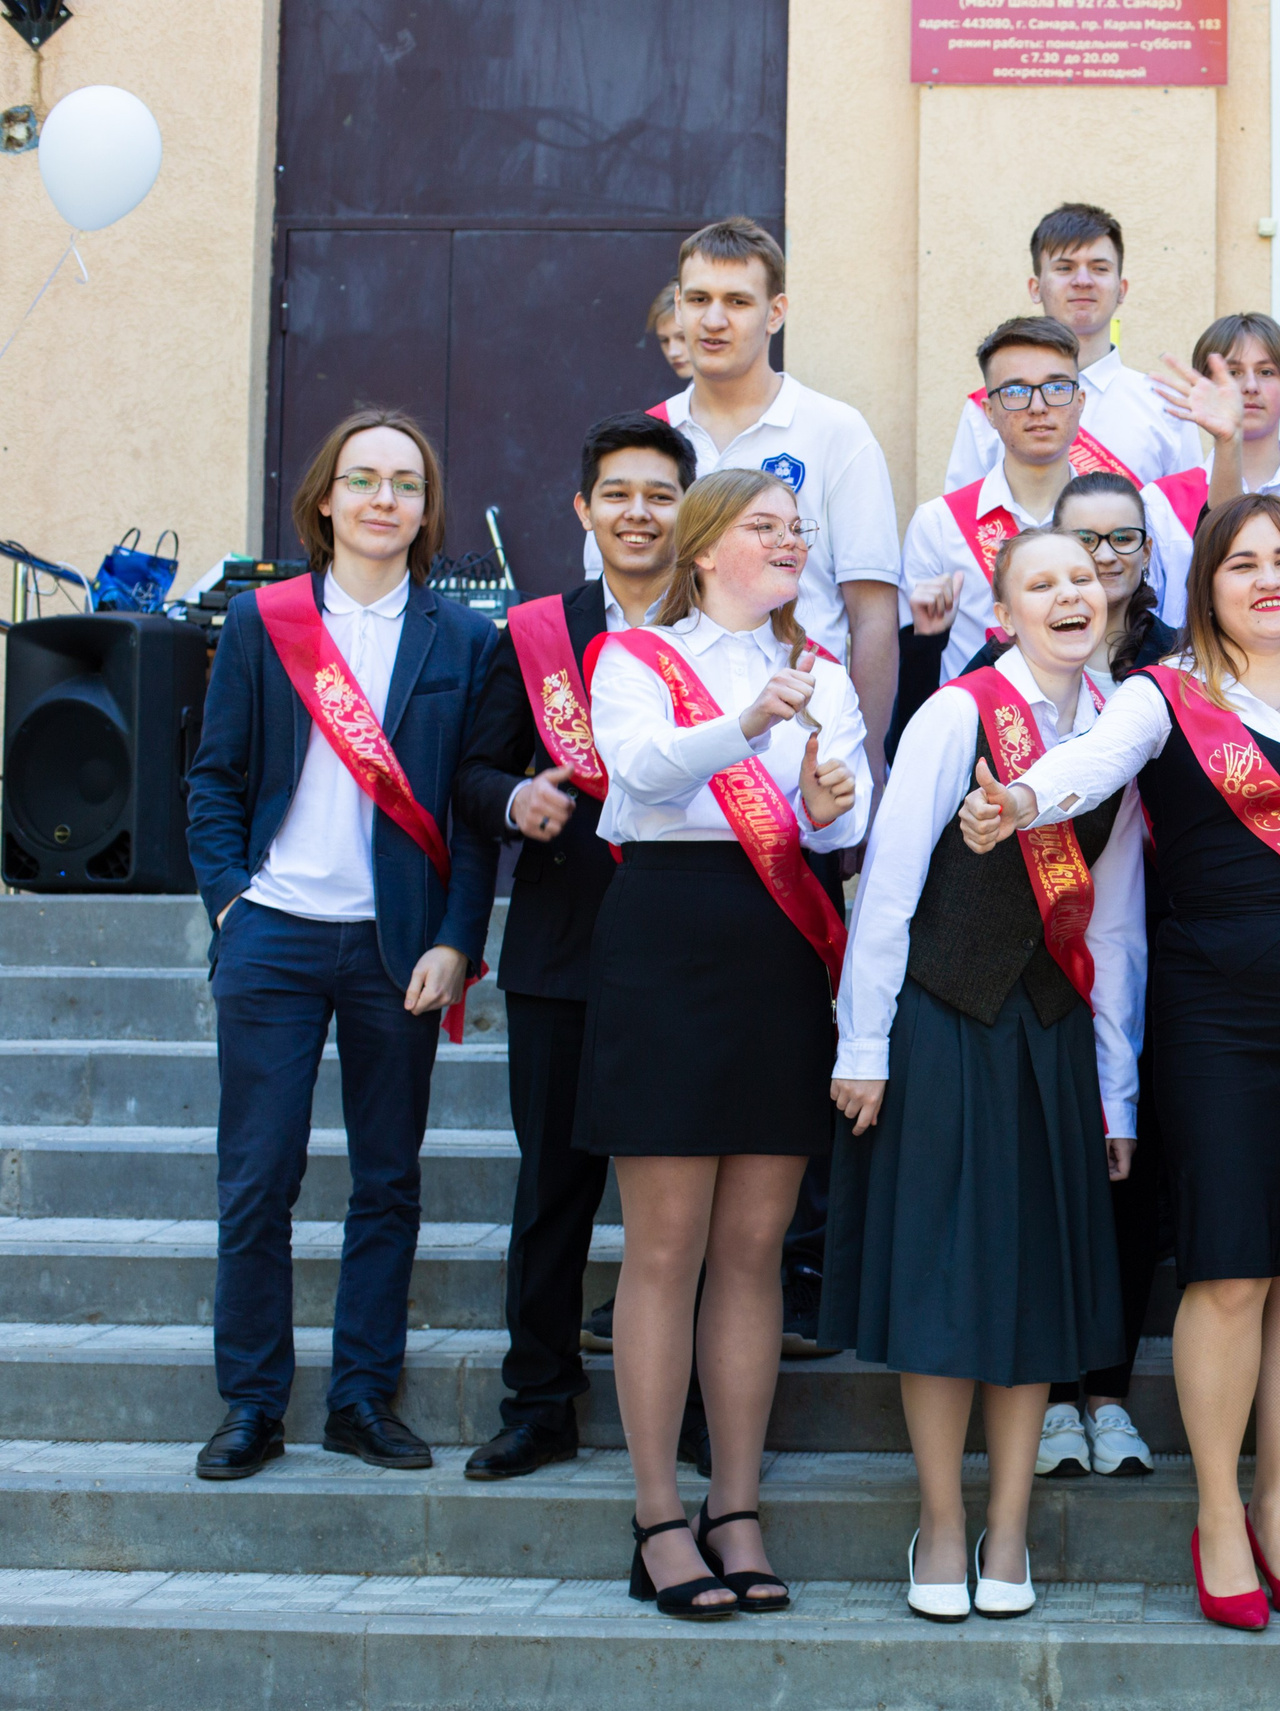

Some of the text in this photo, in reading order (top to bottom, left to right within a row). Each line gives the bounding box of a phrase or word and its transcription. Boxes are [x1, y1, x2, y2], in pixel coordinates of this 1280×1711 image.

[1077, 0, 1095, 9] 92
[919, 18, 960, 30] адрес:
[1016, 20, 1026, 30] г.
[1028, 18, 1080, 31] Самара,
[1082, 20, 1101, 32] пр.
[1104, 19, 1142, 32] Карла
[1144, 19, 1196, 32] Маркса,
[1198, 19, 1222, 31] 183
[948, 38, 991, 50] режим
[993, 37, 1044, 50] работы:
[1046, 39, 1129, 51] понедельник
[1140, 38, 1192, 52] суббота
[1020, 52, 1119, 65] с 7.30 до 20.00
[993, 67, 1074, 79] воскресенье
[1083, 66, 1147, 79] выходной
